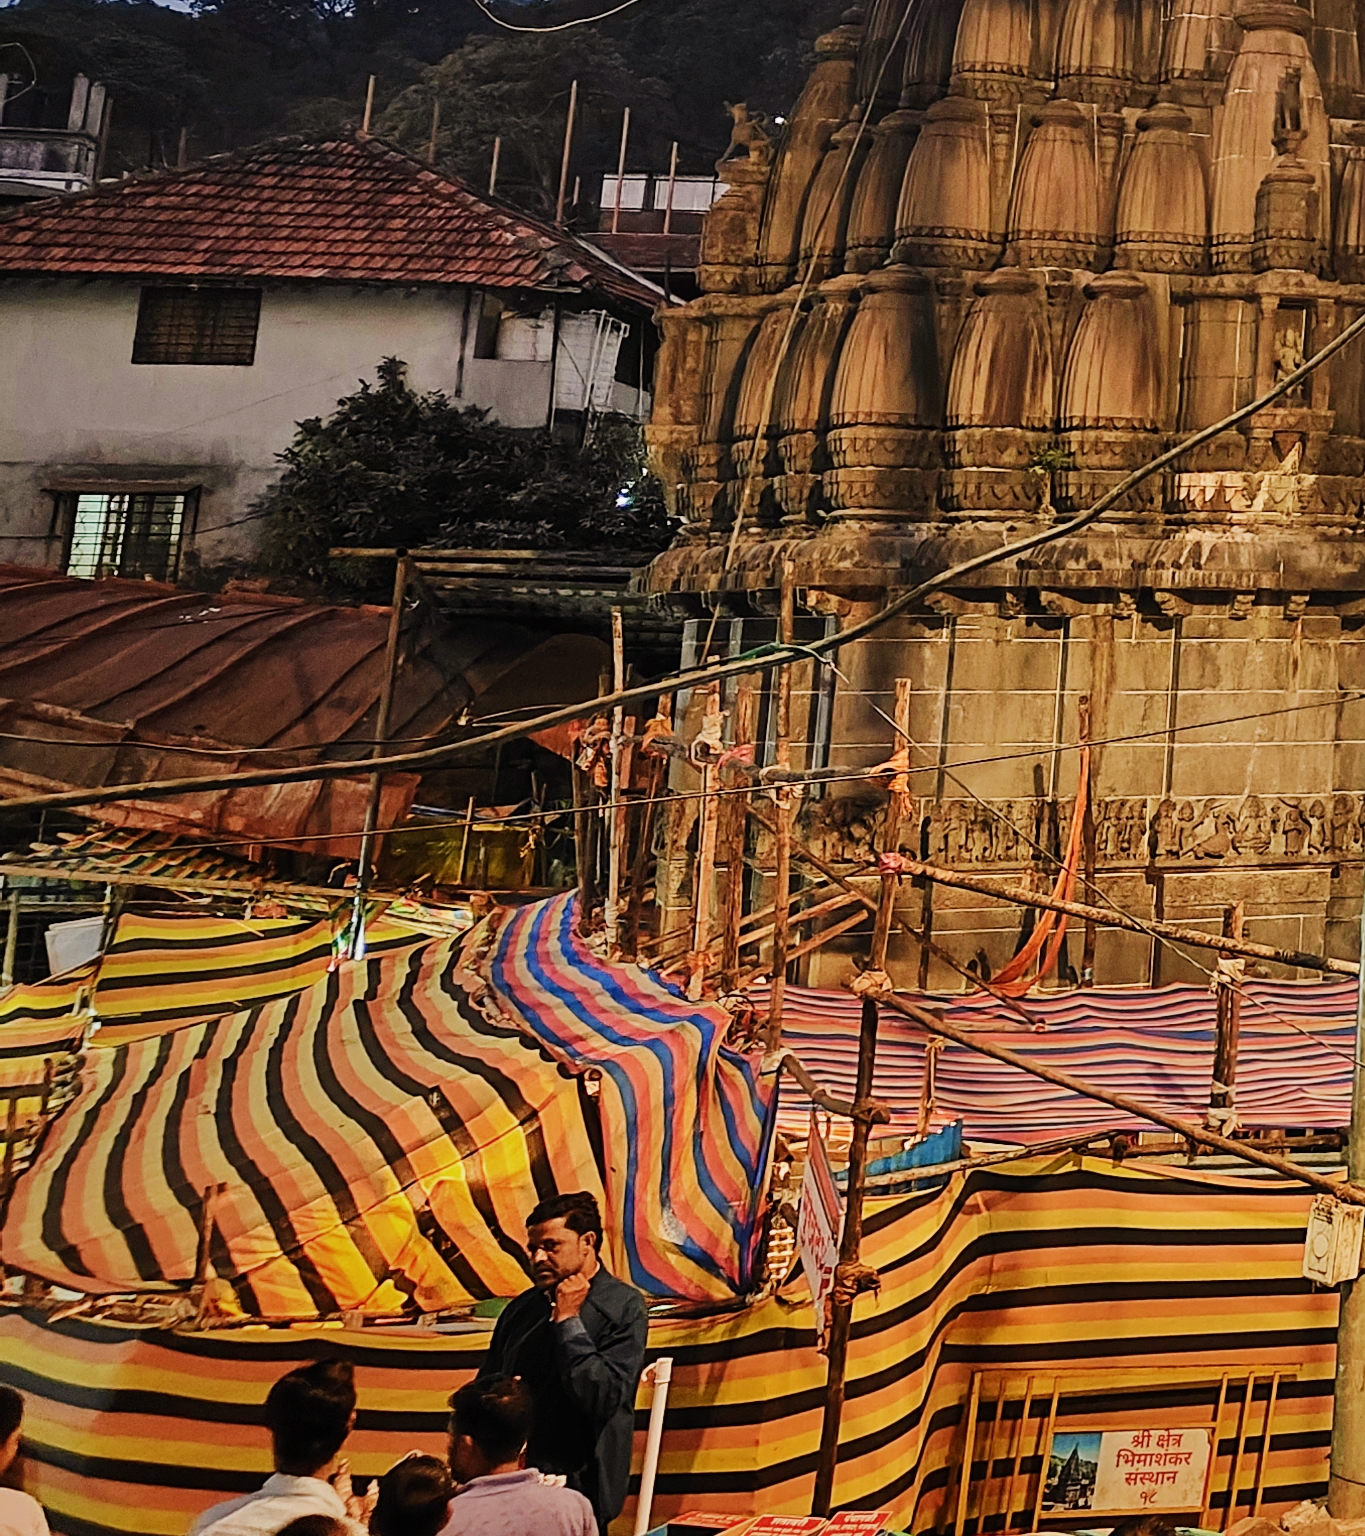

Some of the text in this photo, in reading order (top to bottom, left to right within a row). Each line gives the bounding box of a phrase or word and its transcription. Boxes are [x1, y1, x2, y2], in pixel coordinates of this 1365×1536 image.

[1132, 1430, 1183, 1448] श्री क्षेत्र
[1115, 1449, 1193, 1468] भिमाशंकर
[1124, 1468, 1178, 1486] संस्थान
[1140, 1491, 1158, 1505] १८
